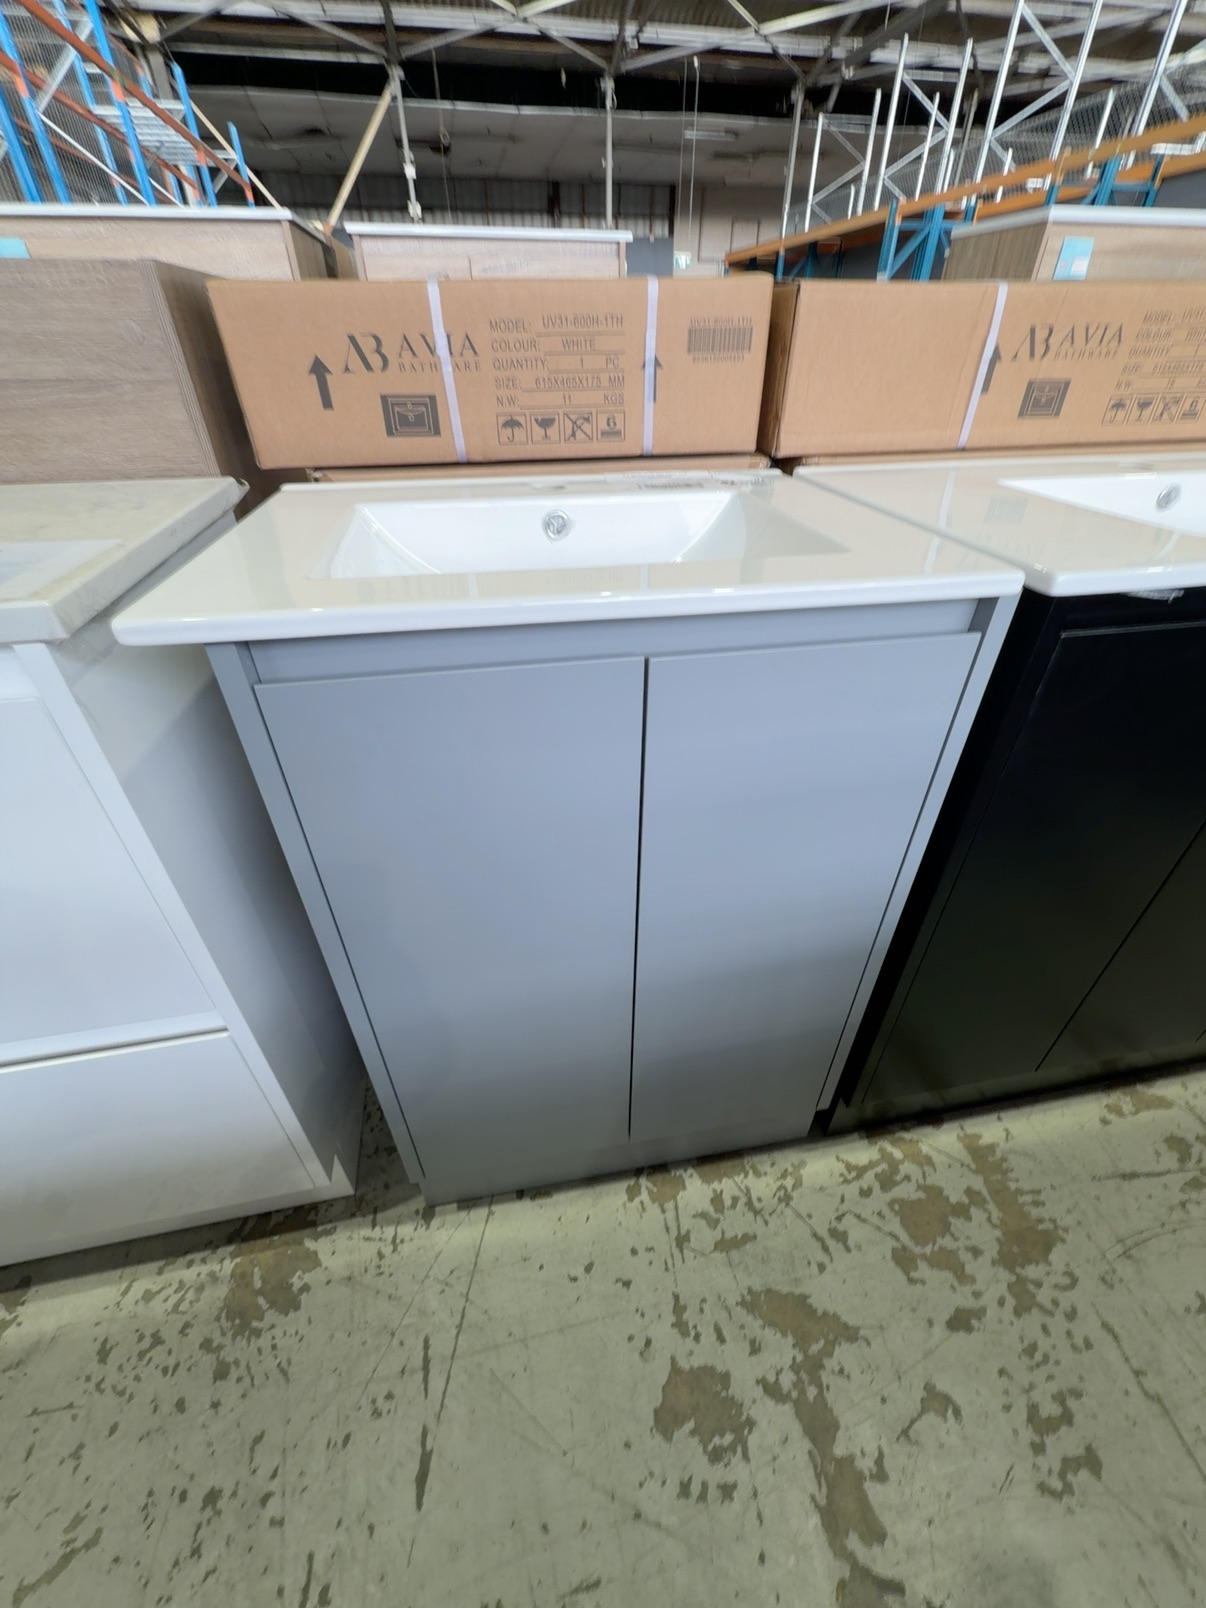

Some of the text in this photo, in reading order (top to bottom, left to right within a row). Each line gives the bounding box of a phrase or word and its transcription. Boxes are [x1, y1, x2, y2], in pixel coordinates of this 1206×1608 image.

[489, 318, 532, 334] MODEL:
[1057, 321, 1124, 350] AVIA
[491, 336, 597, 353] COLOUR: WHITE
[397, 359, 482, 374] BATHARE
[492, 356, 550, 372] QUANTITY:
[605, 354, 621, 370] PC
[494, 375, 523, 391] SIZE:
[608, 374, 625, 389] MM
[603, 391, 625, 406] KGS
